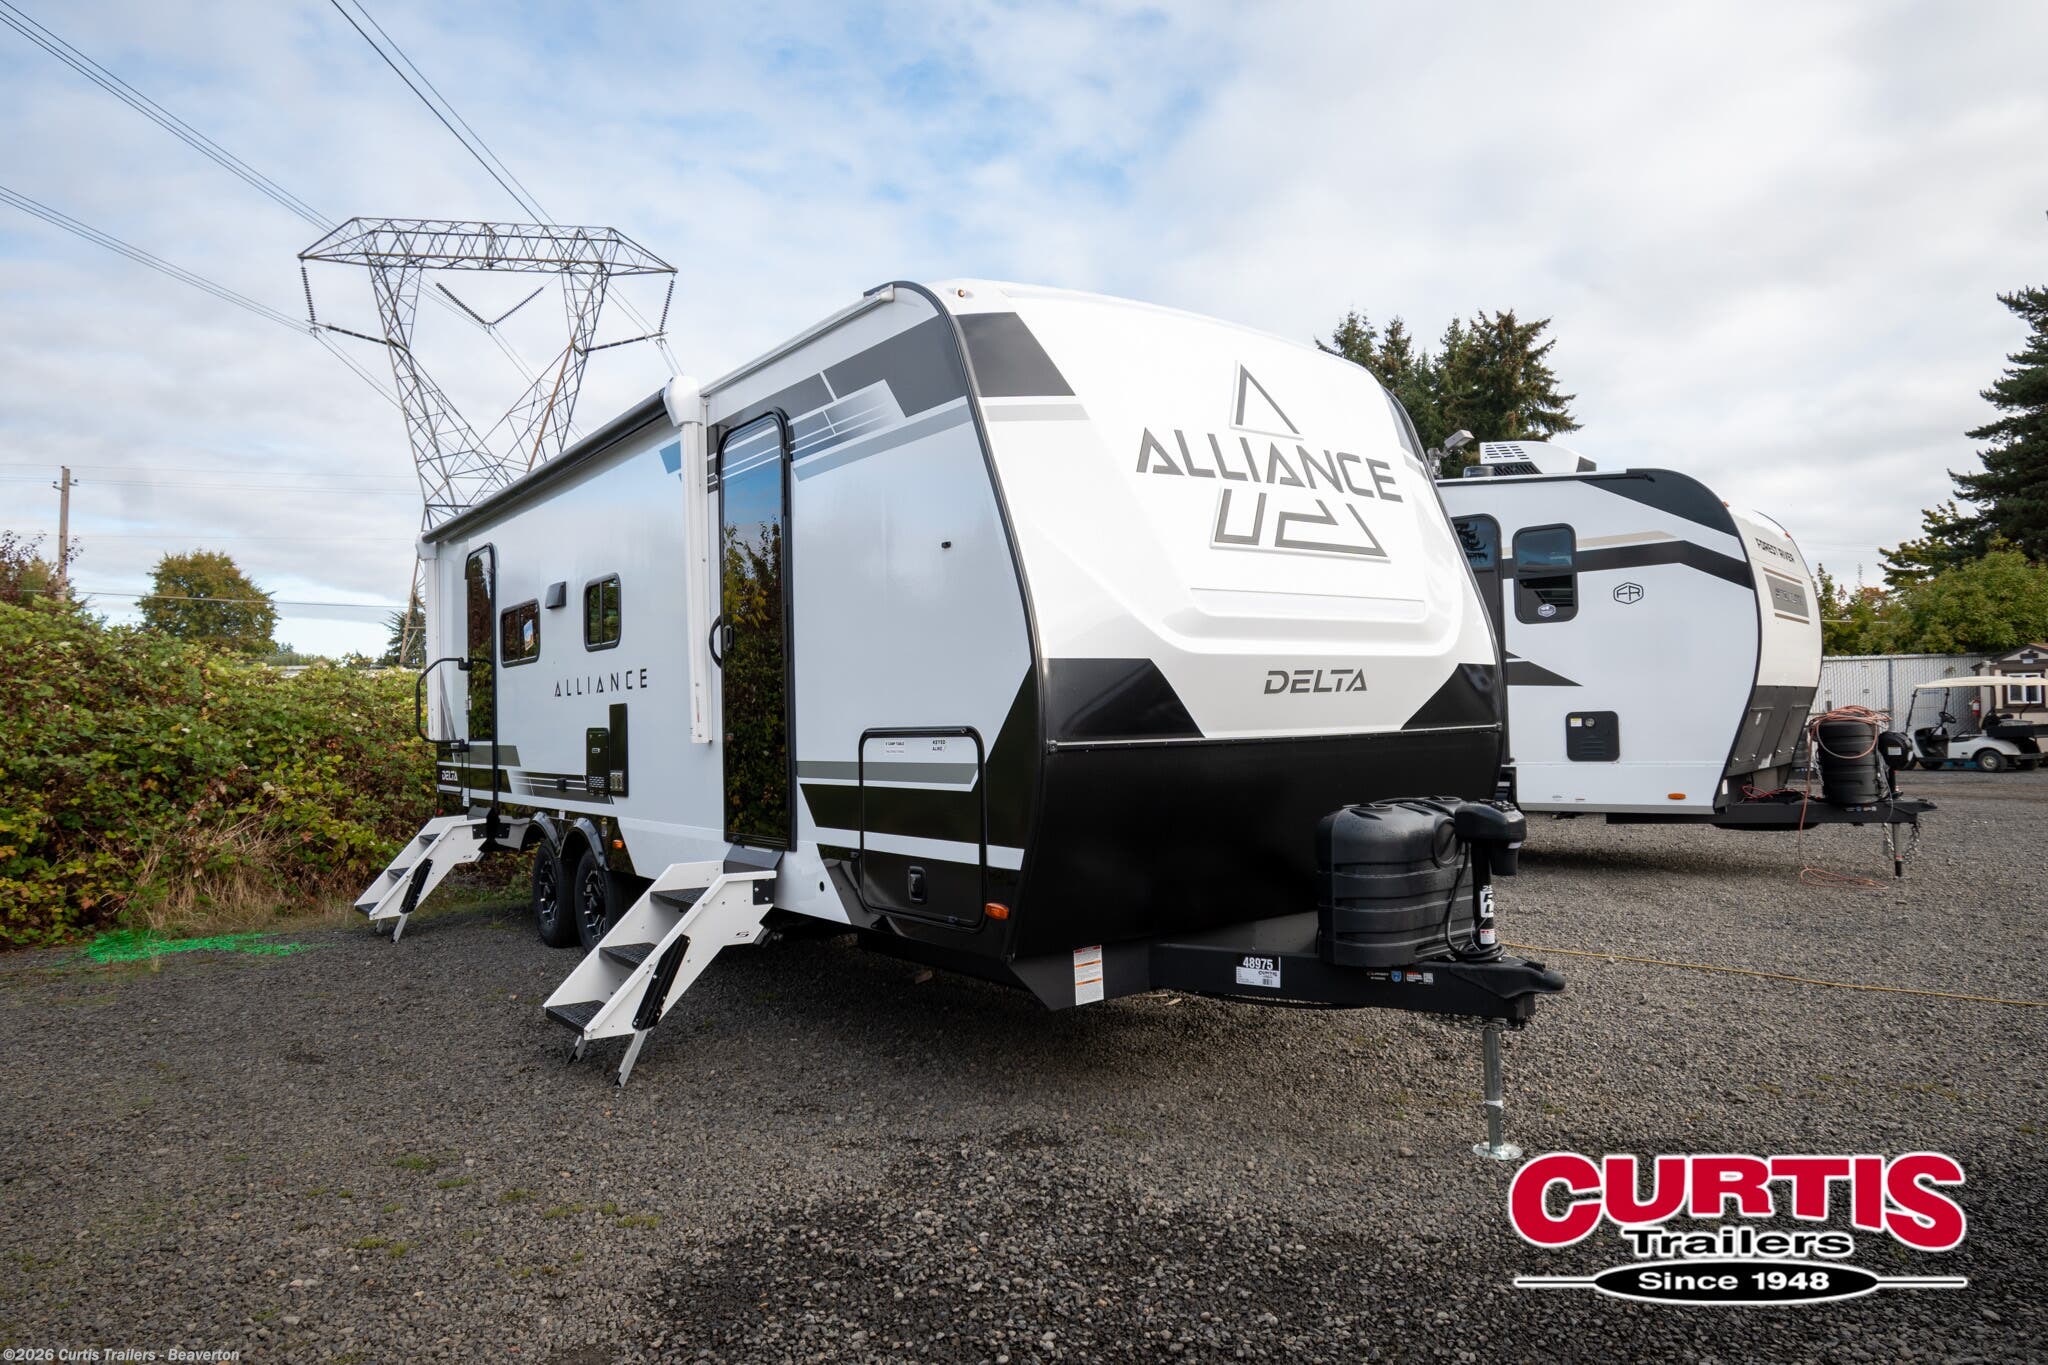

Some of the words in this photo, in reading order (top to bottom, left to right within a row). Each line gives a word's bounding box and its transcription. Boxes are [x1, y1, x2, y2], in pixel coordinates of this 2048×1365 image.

[1136, 427, 1403, 503] ALLIANCE
[1755, 537, 1777, 556] FOREST
[1777, 547, 1795, 562] RIVER
[554, 668, 648, 698] ALLIANCE
[1263, 668, 1368, 694] DELTA
[441, 770, 458, 781] DELTA
[1242, 956, 1274, 970] 48975
